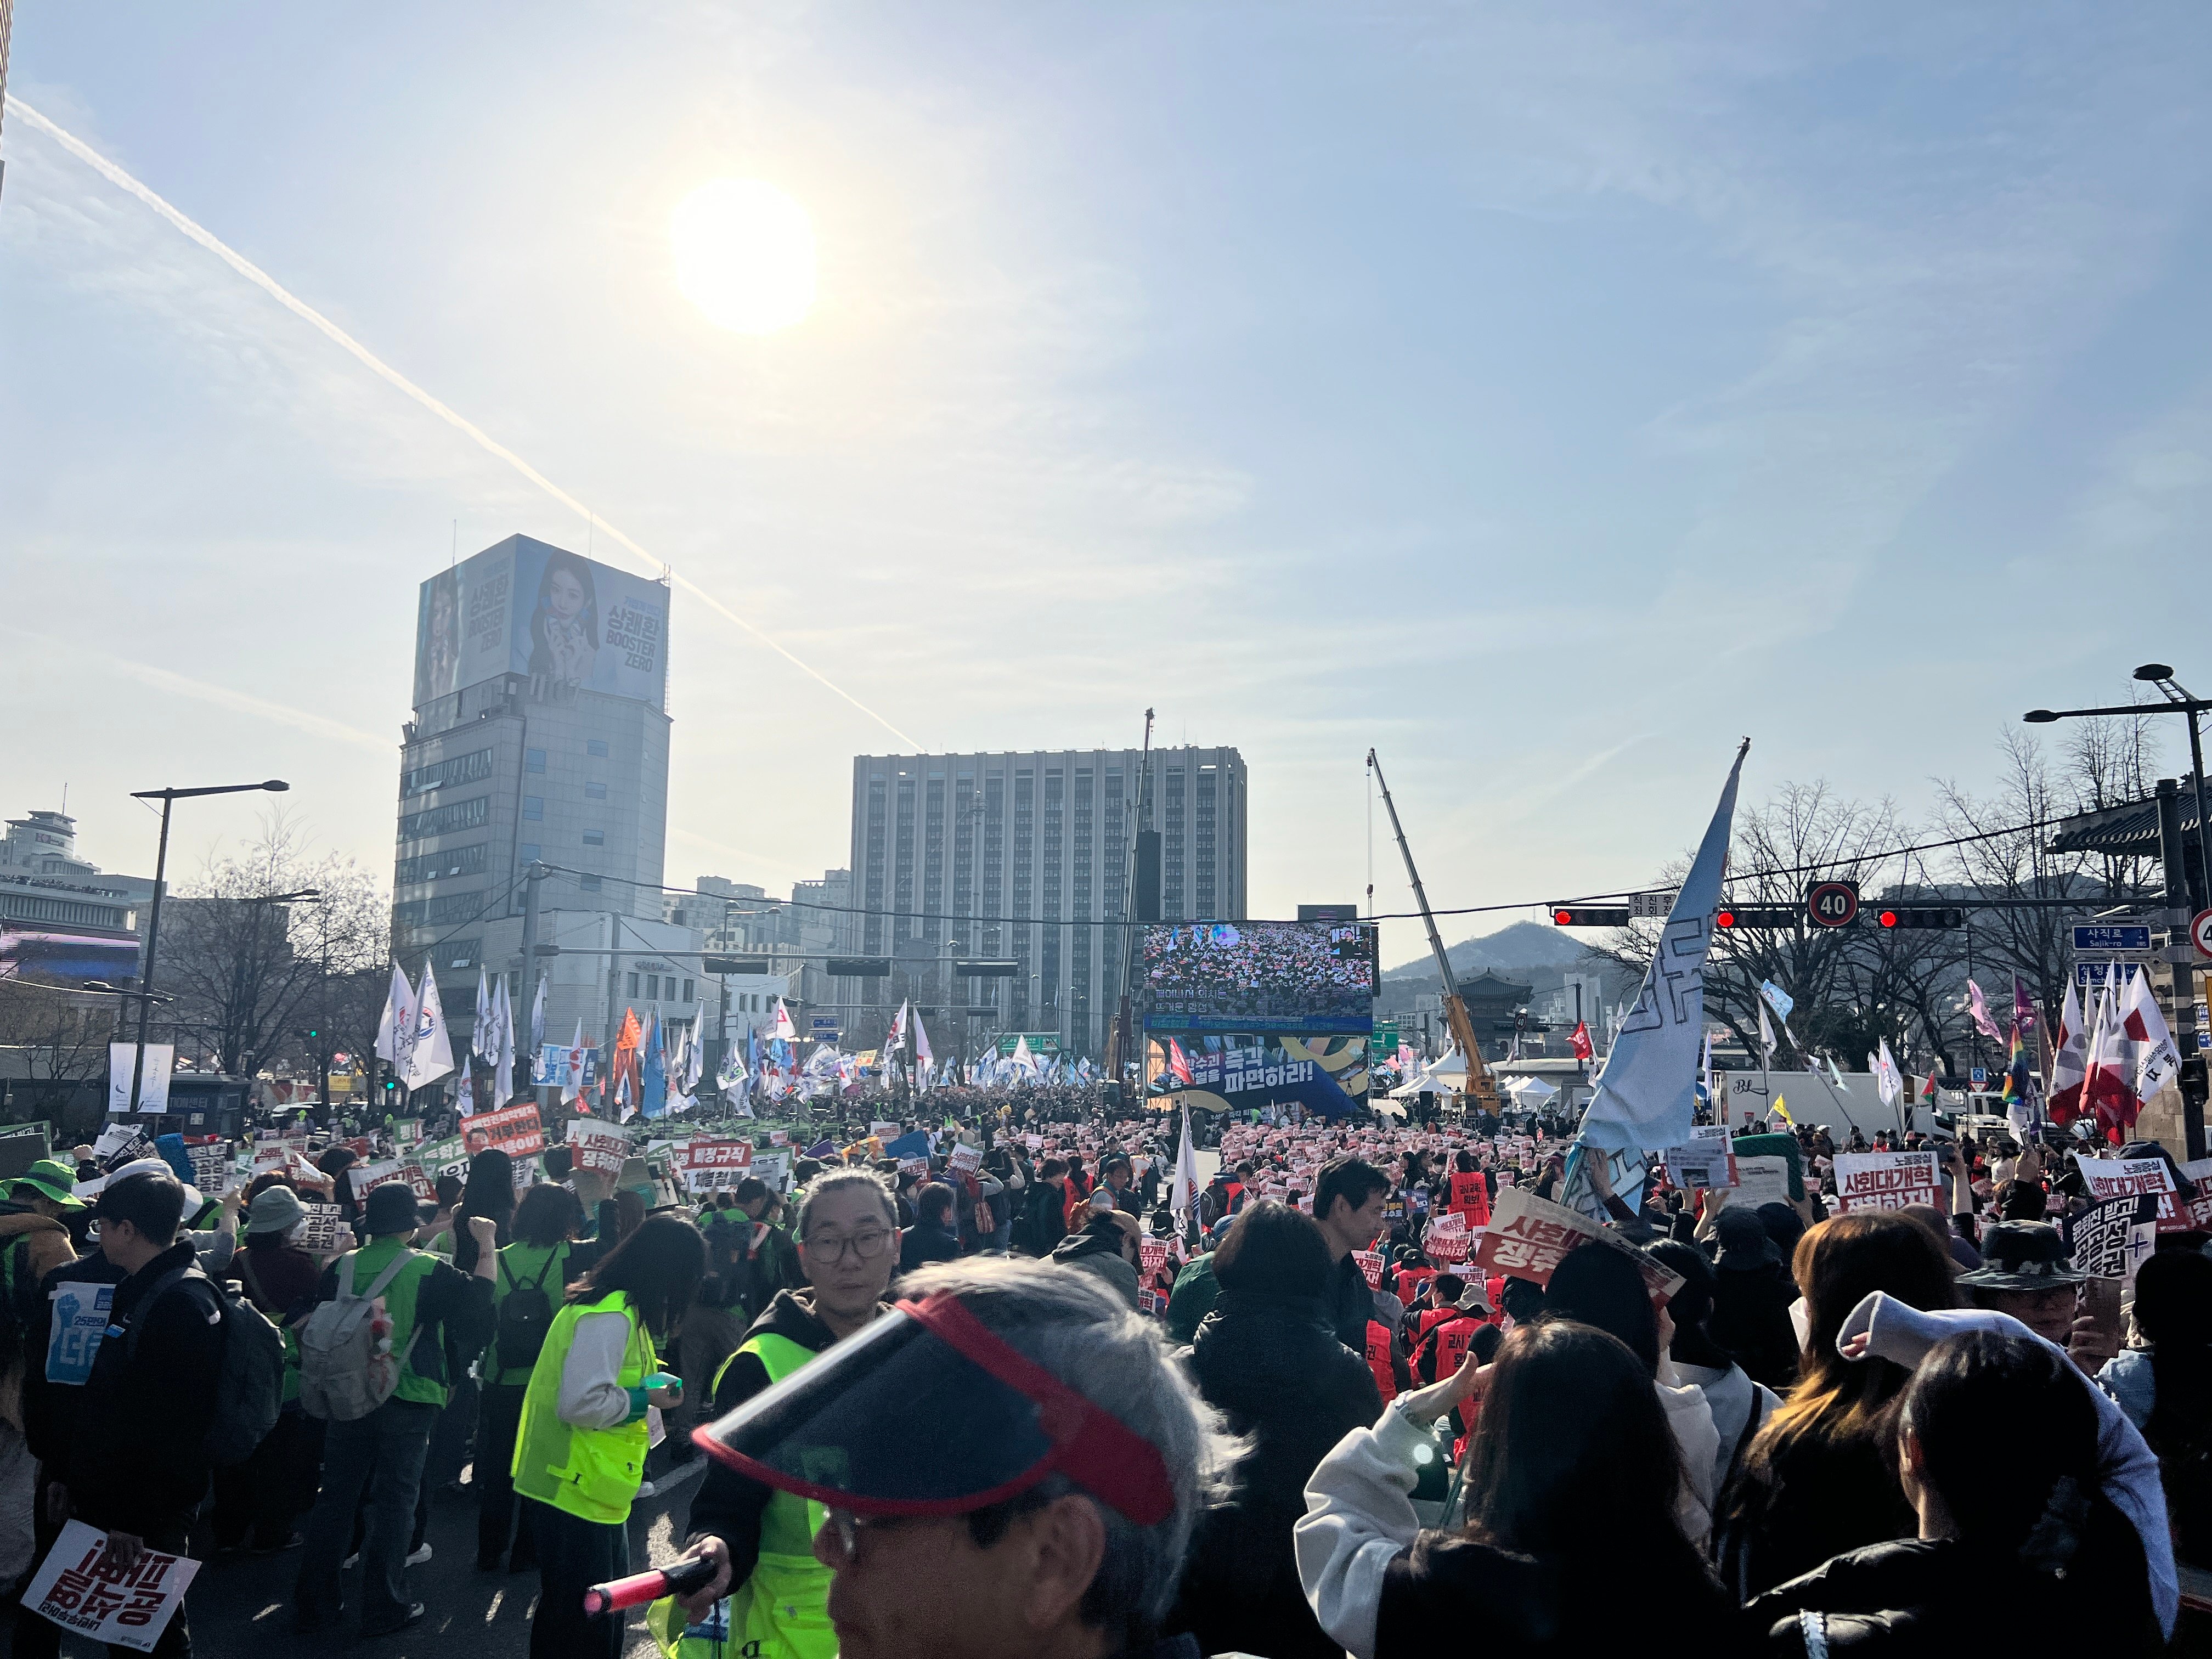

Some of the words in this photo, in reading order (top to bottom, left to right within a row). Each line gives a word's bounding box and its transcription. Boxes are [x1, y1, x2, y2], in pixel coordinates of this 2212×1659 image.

[607, 605, 659, 642] 상쾌환
[606, 629, 656, 658] BOOSTER
[624, 652, 653, 673] ZERO
[1820, 895, 1846, 915] 40
[2087, 928, 2123, 939] 사직로
[1517, 1018, 1526, 1028] 40
[1224, 1046, 1265, 1070] 즉각
[1224, 1061, 1314, 1094] 파면하라!
[1894, 1154, 1932, 1167] 노동중심
[1845, 1164, 1933, 1194] 사회대개혁
[2072, 1206, 2101, 1243] 윤퇴진
[2104, 1197, 2139, 1222] 받고!
[1429, 1233, 1470, 1248] 사회대개혁
[44, 1567, 168, 1627] 윤석열
